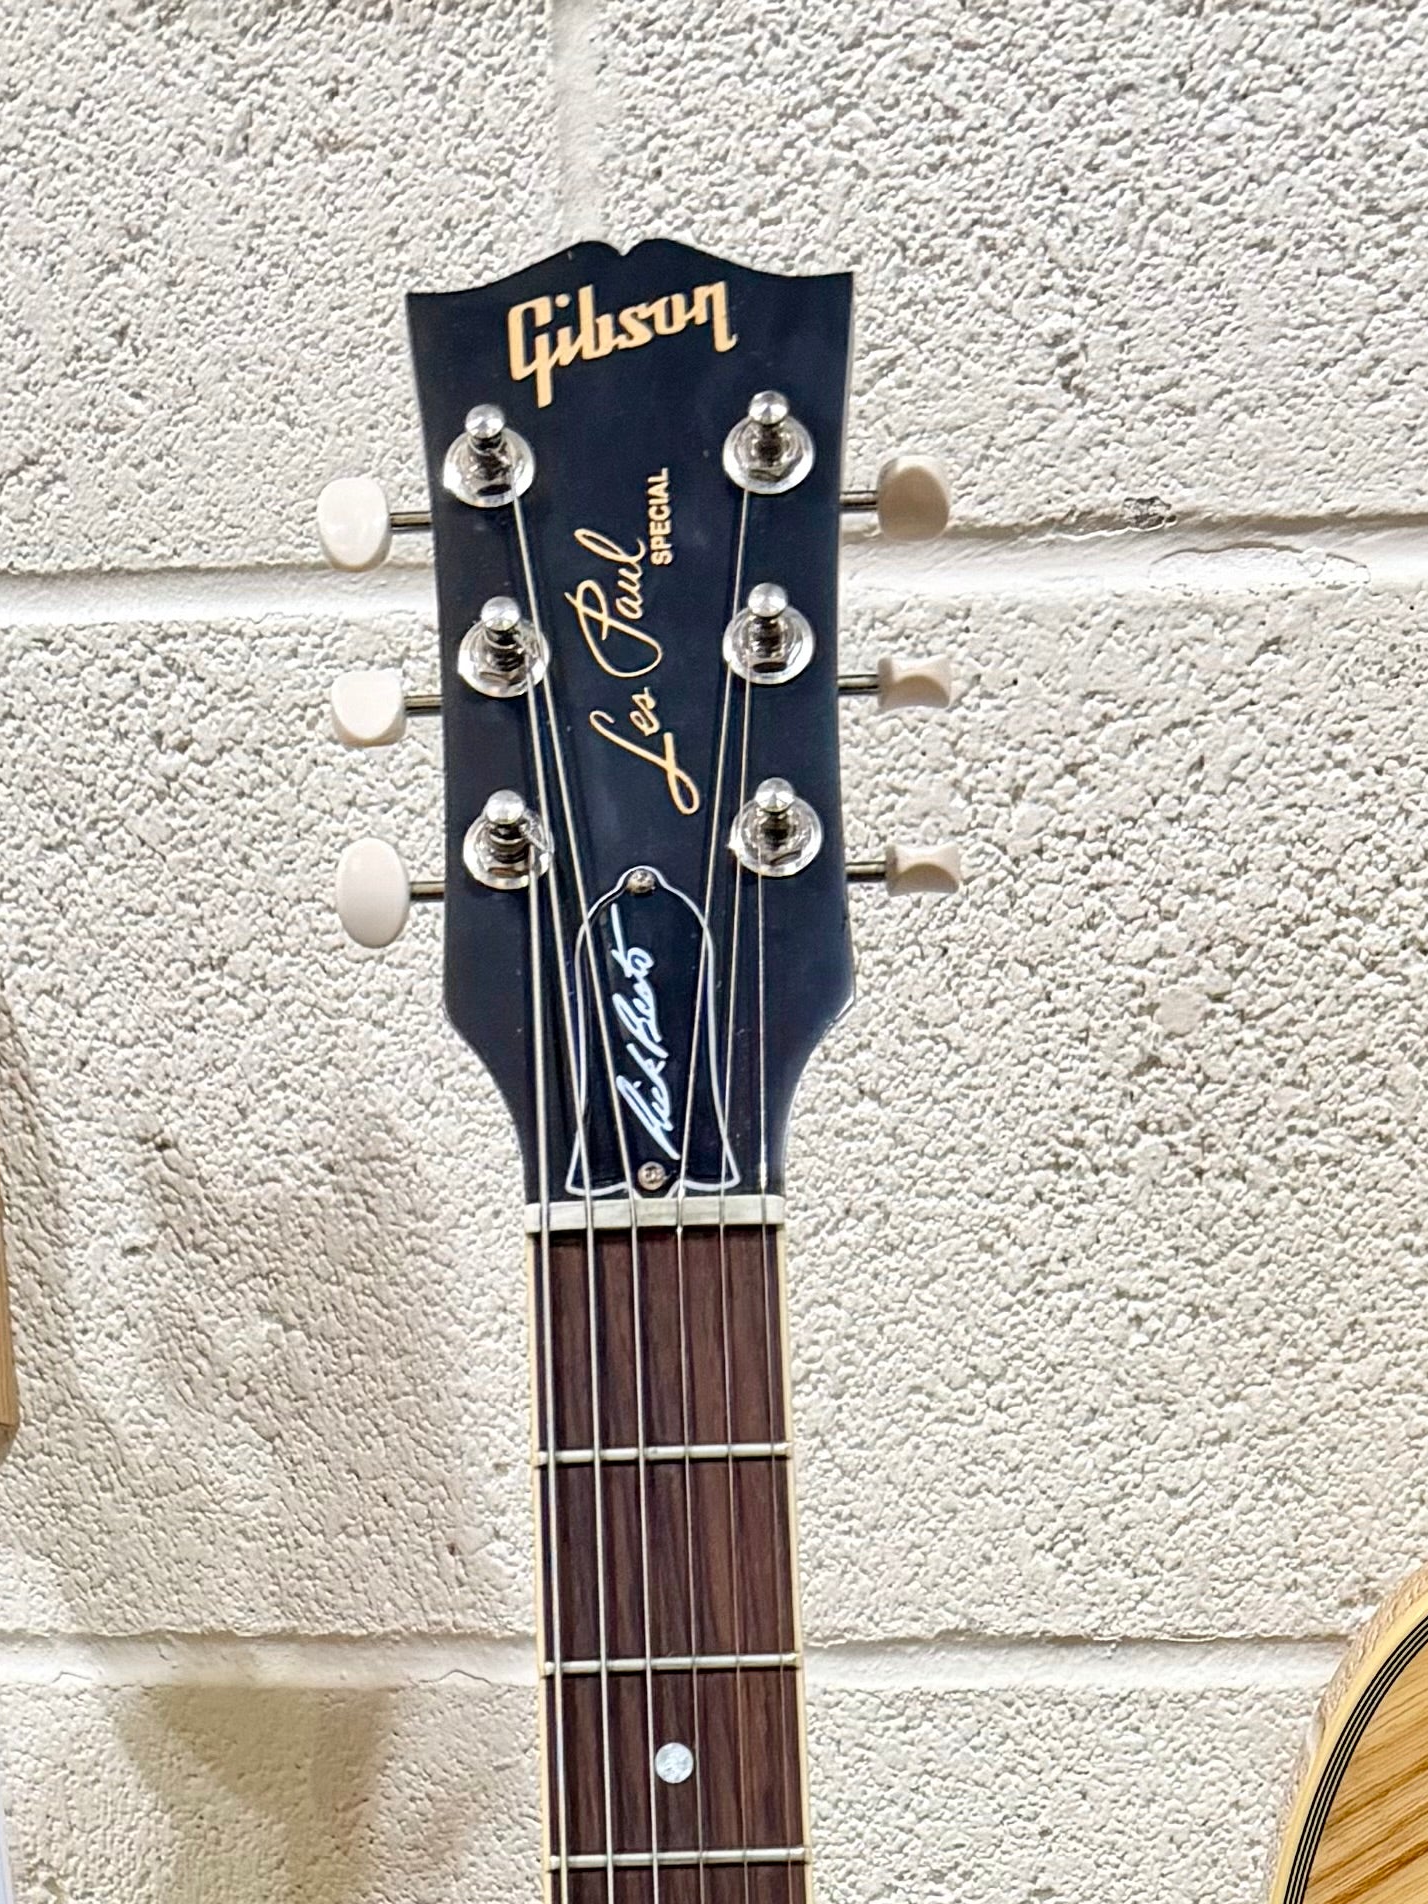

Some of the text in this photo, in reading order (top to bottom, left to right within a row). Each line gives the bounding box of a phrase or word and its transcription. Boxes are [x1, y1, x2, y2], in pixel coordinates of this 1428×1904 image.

[508, 280, 739, 409] Gibson
[647, 467, 673, 567] SPECIAL
[564, 528, 700, 815] Les Paul
